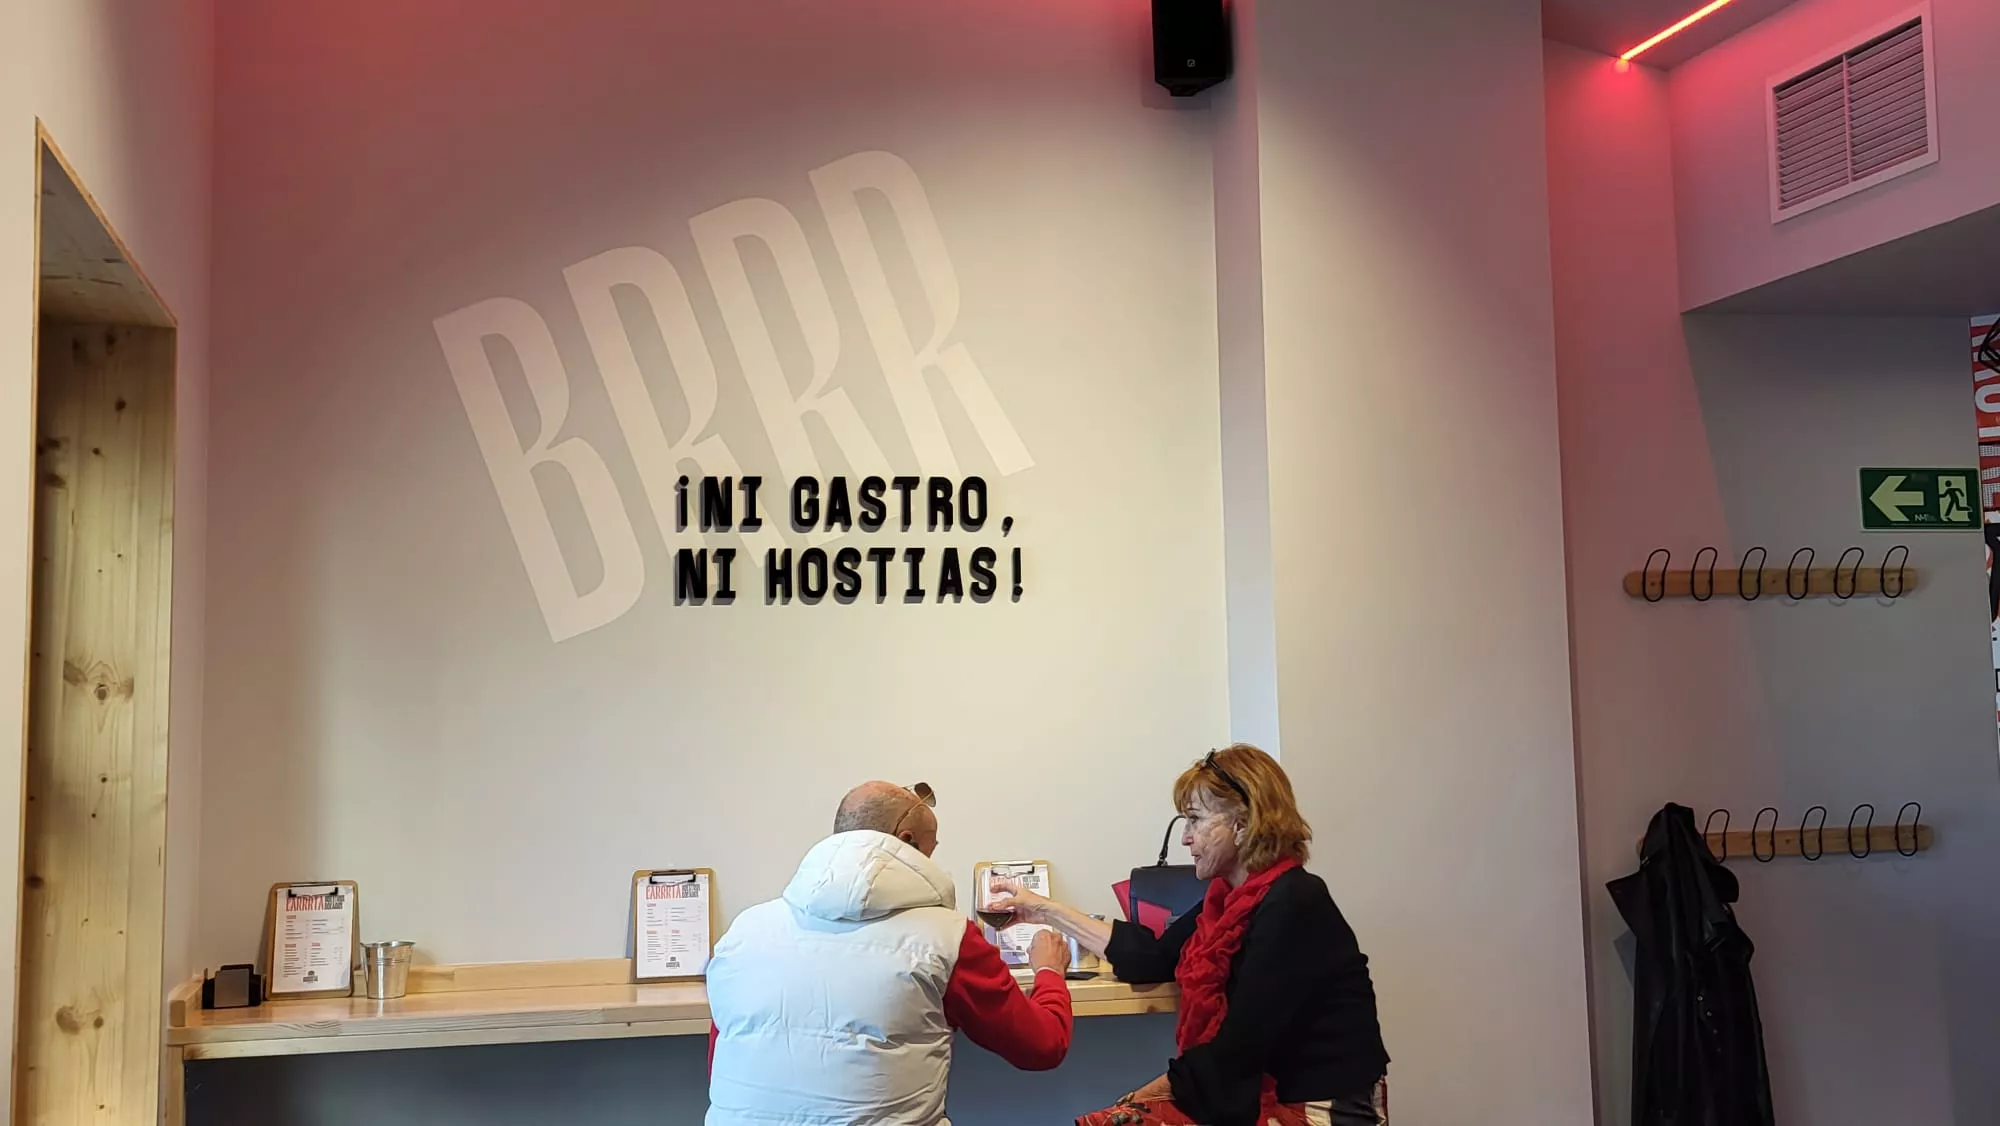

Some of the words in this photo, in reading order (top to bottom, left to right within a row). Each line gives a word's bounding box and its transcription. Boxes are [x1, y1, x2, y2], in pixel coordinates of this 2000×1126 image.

[432, 150, 1035, 643] BRRR
[677, 475, 763, 530] ¡NI
[791, 475, 1015, 536] GASTRO,
[678, 546, 737, 603] NI
[768, 546, 1024, 603] HOSTIAS!
